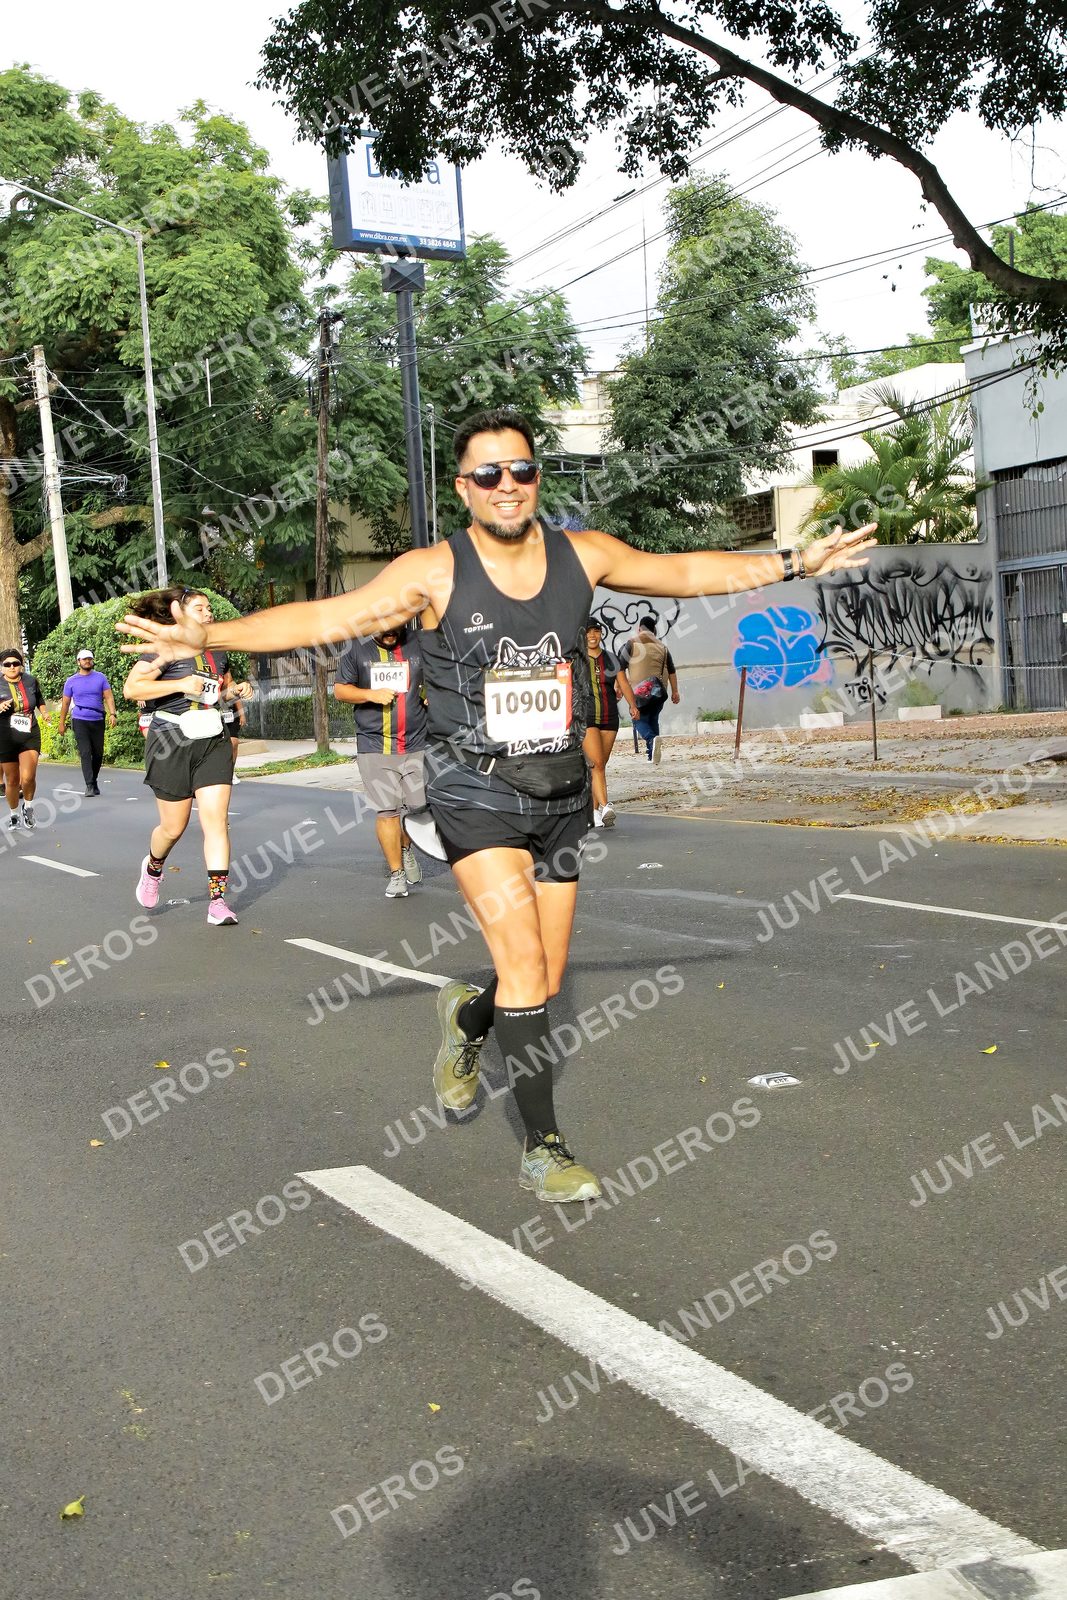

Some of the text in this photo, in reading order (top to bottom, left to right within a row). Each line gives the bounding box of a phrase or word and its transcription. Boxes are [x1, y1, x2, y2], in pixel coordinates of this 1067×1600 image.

[359, 232, 408, 243] www.dibra.com.mx
[419, 237, 427, 245] 33
[463, 622, 494, 633] TOPTIME
[491, 688, 562, 715] 10900
